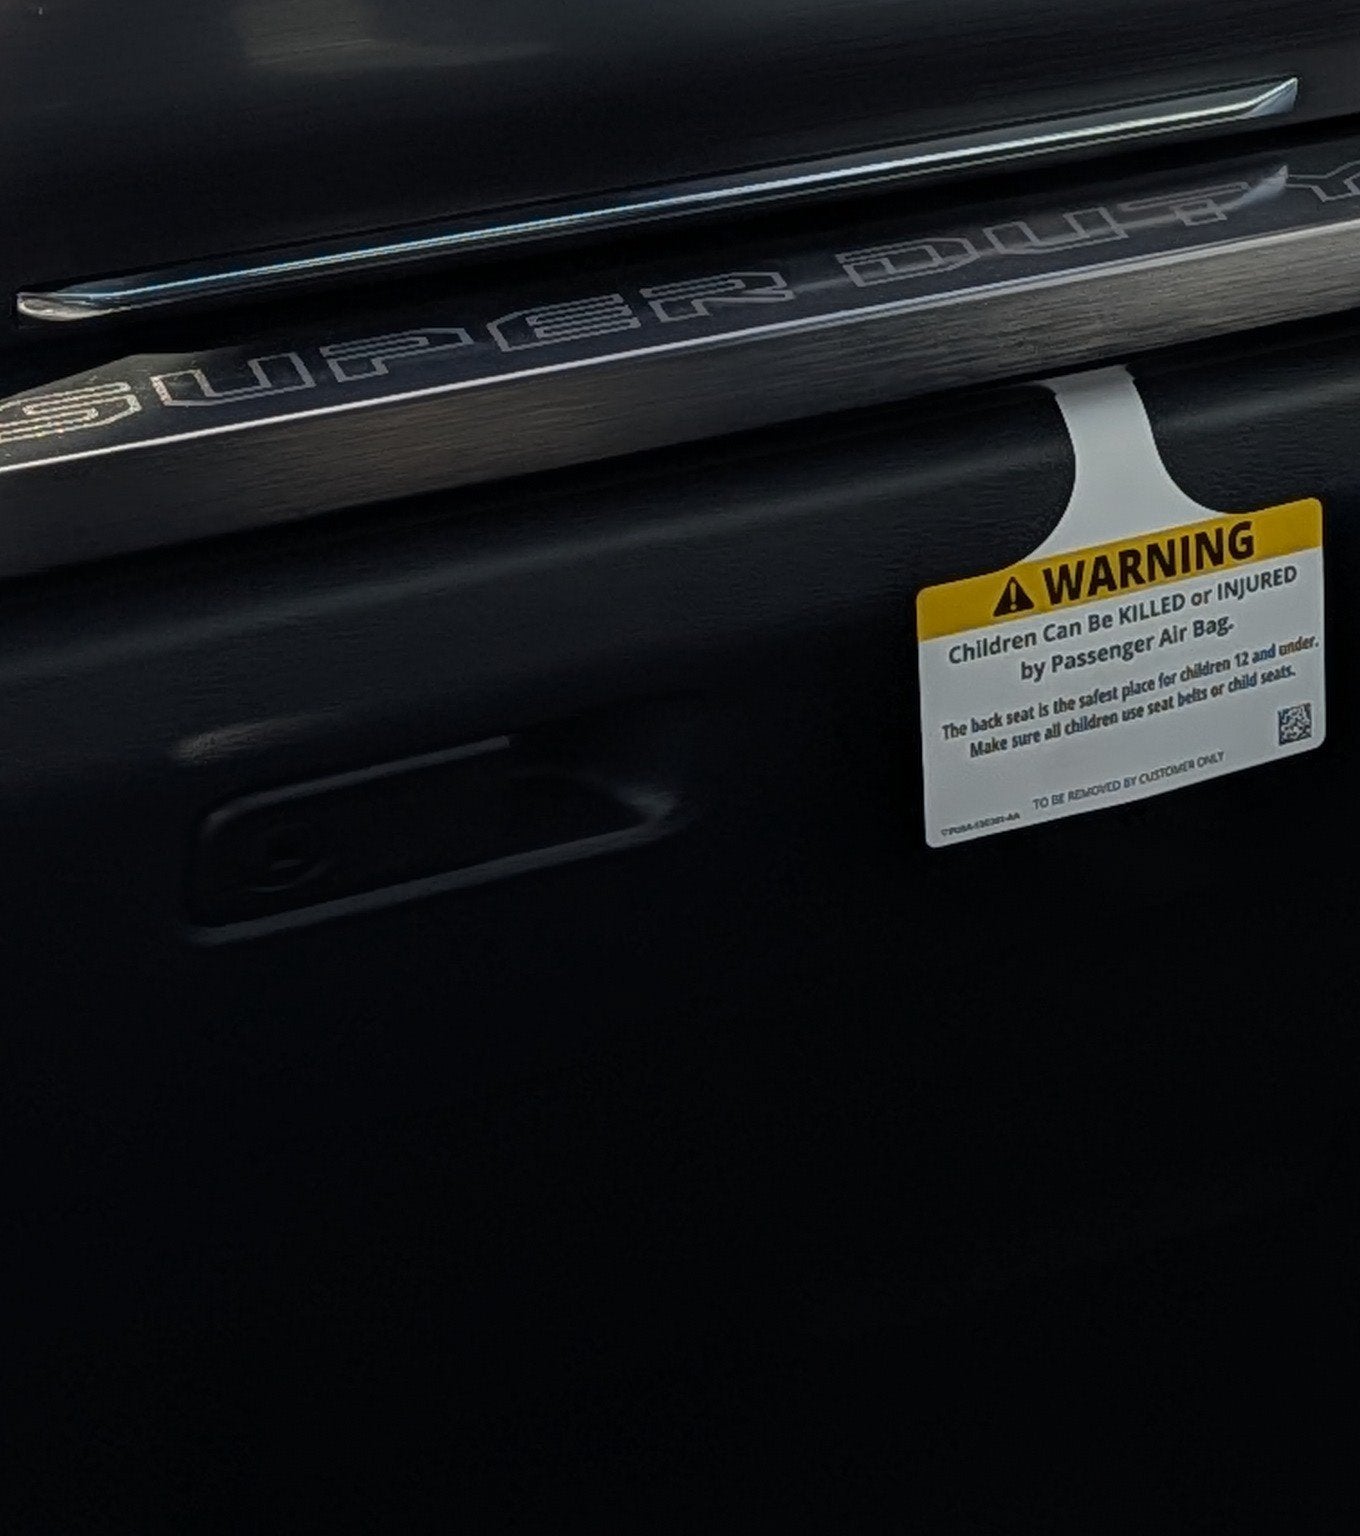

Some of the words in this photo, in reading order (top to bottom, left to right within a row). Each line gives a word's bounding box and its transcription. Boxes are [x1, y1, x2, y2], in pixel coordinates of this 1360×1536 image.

[0, 272, 795, 444] SUPER
[1042, 520, 1255, 606] WARNING
[948, 632, 1037, 664] Children
[1043, 621, 1082, 642] Can
[1088, 614, 1113, 633] Be
[1118, 593, 1186, 625] KILLED
[1191, 590, 1213, 606] or
[1217, 566, 1298, 601] INJURED
[1021, 661, 1047, 683] by
[1051, 636, 1155, 674] Passenger
[1158, 625, 1187, 647] Air
[1192, 616, 1235, 637] Bag.
[942, 722, 968, 740] The
[971, 713, 1004, 734] back
[1006, 707, 1035, 726] seat
[1038, 703, 1049, 717] is
[1053, 697, 1076, 714] the
[1078, 686, 1118, 709] safest
[1121, 678, 1156, 702] place
[1158, 672, 1177, 688] for
[1180, 658, 1231, 682] children
[1234, 651, 1249, 668] 12
[1252, 644, 1276, 663] and
[1278, 635, 1320, 657] under.
[970, 740, 1008, 758] Make
[1012, 731, 1041, 748] sure
[1044, 721, 1062, 740] all
[1064, 712, 1118, 735] children
[1121, 705, 1145, 722] use
[1147, 695, 1174, 715] seat
[1177, 686, 1208, 708] belts
[1210, 683, 1225, 698] or
[1228, 672, 1258, 694] child
[1260, 664, 1296, 685] seats.
[1033, 796, 1049, 810] TO
[1052, 794, 1065, 806] BE
[1068, 779, 1121, 802] REMOVED
[1123, 775, 1137, 789] BY
[1138, 759, 1195, 786] CUSTOMER
[1197, 751, 1224, 769] ONLY
